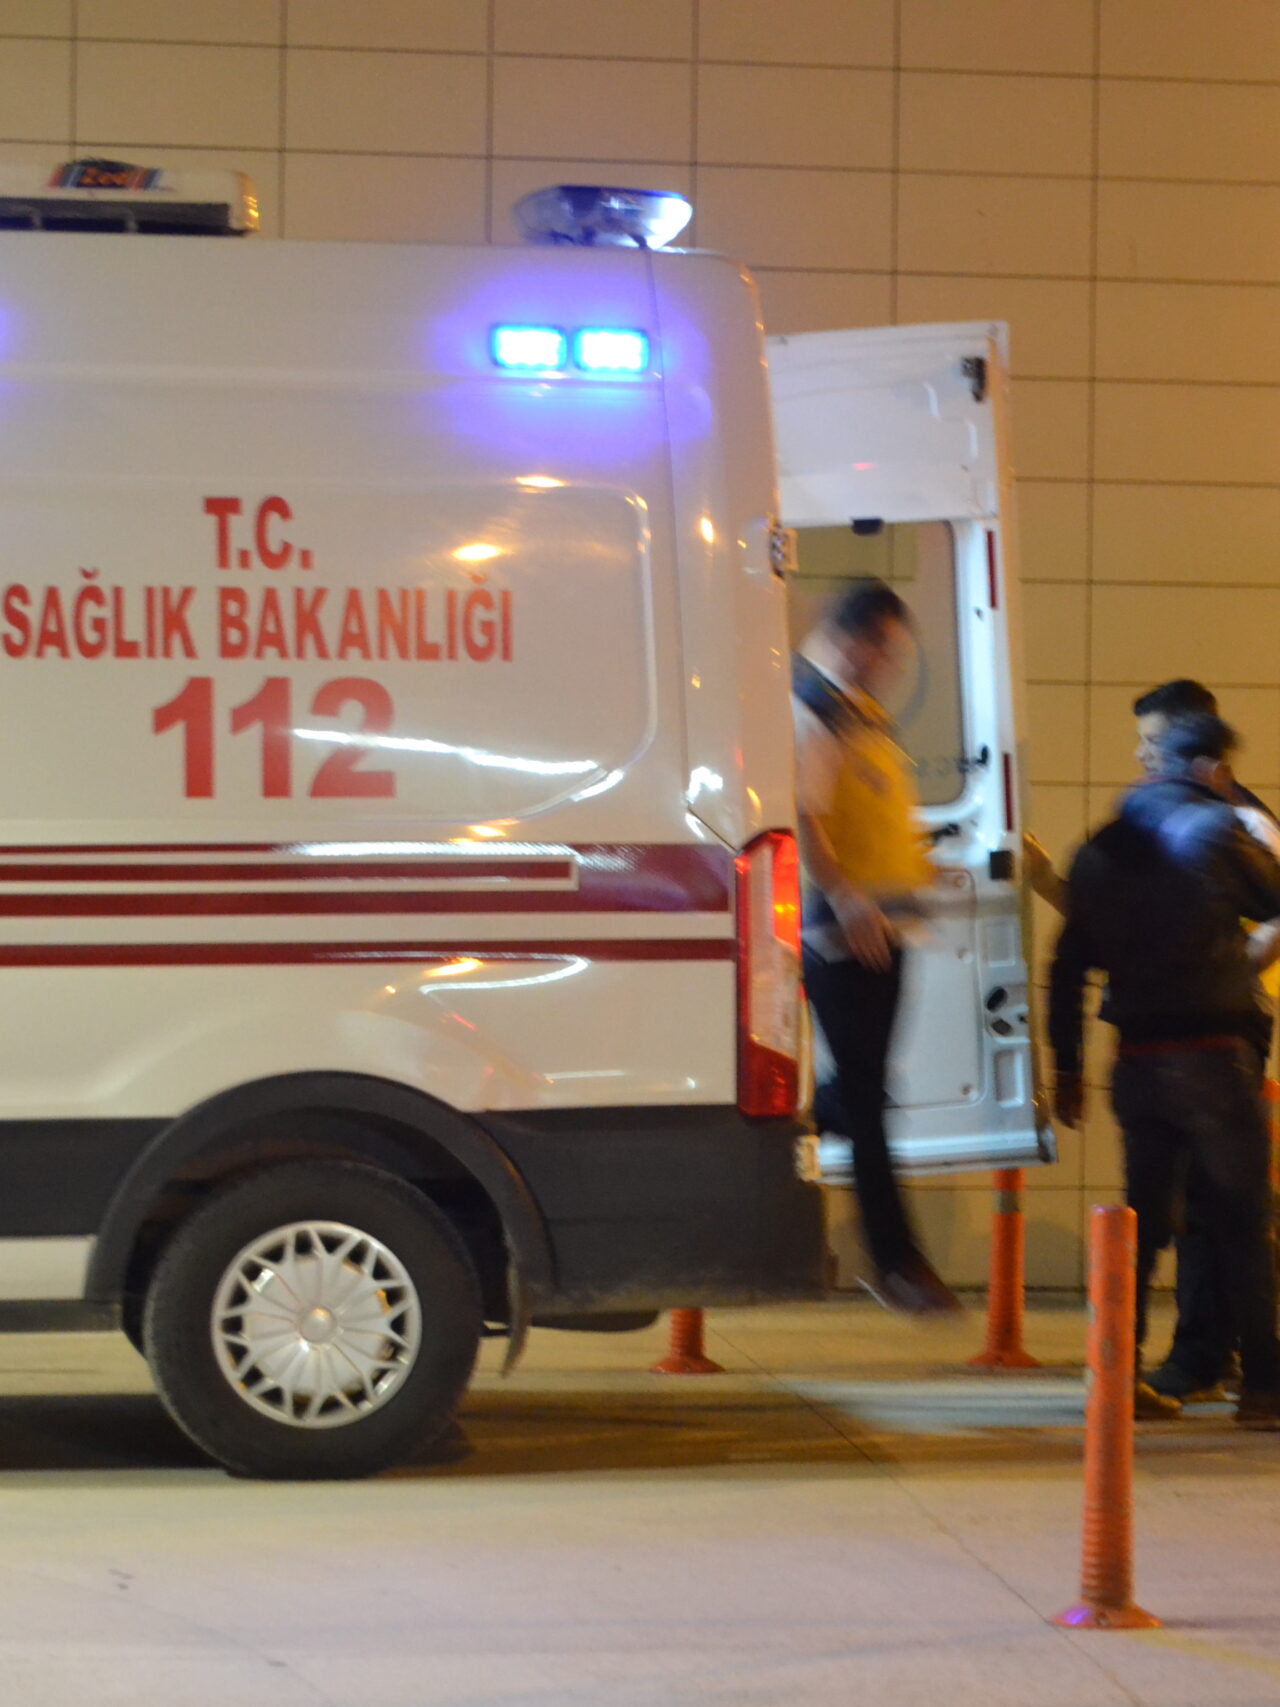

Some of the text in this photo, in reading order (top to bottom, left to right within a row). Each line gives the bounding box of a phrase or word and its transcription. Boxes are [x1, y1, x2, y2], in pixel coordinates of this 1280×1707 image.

[203, 495, 313, 570] T.C.
[2, 567, 512, 662] SAĞLIK BAKANLIĞI
[152, 676, 396, 799] 112
